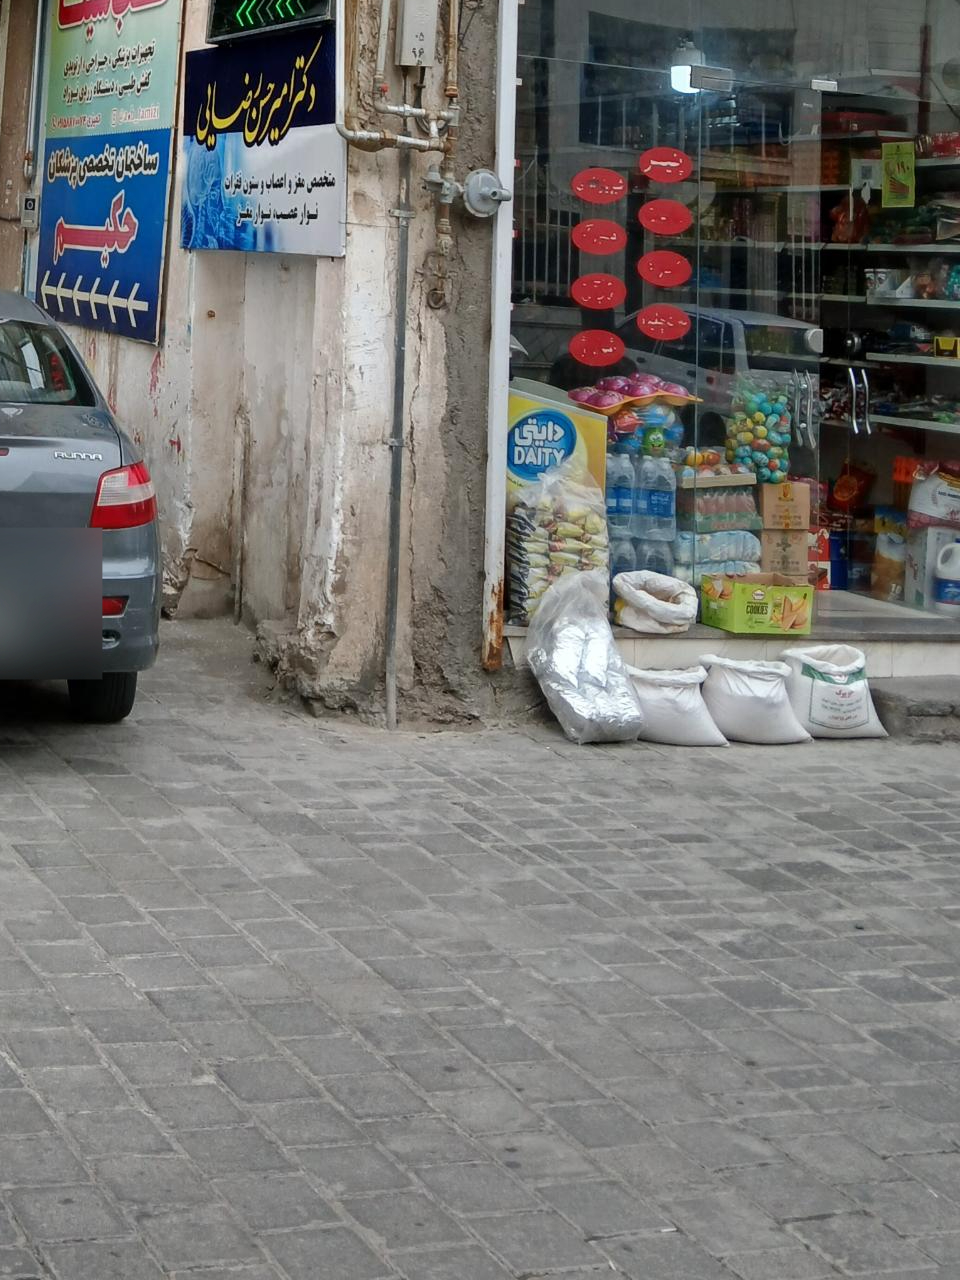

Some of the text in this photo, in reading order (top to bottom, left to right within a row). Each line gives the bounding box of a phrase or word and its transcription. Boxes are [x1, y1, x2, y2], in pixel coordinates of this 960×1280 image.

[280, 35, 323, 136] دکتر
[48, 141, 159, 189] ساختمان تخصصی پزشکان
[224, 173, 242, 195] فقرات
[243, 176, 259, 195] ستون
[265, 173, 287, 194] اعصاب
[293, 176, 305, 195] مغز
[306, 170, 336, 194] متخصص
[236, 208, 253, 227] مغز
[253, 203, 272, 226] نوار
[300, 203, 319, 225] نوار
[54, 190, 138, 268] حکیم
[514, 417, 565, 447] دایتی
[54, 450, 103, 461] RUNNA
[513, 446, 566, 466] DAITY
[745, 604, 769, 615] COOKIES
